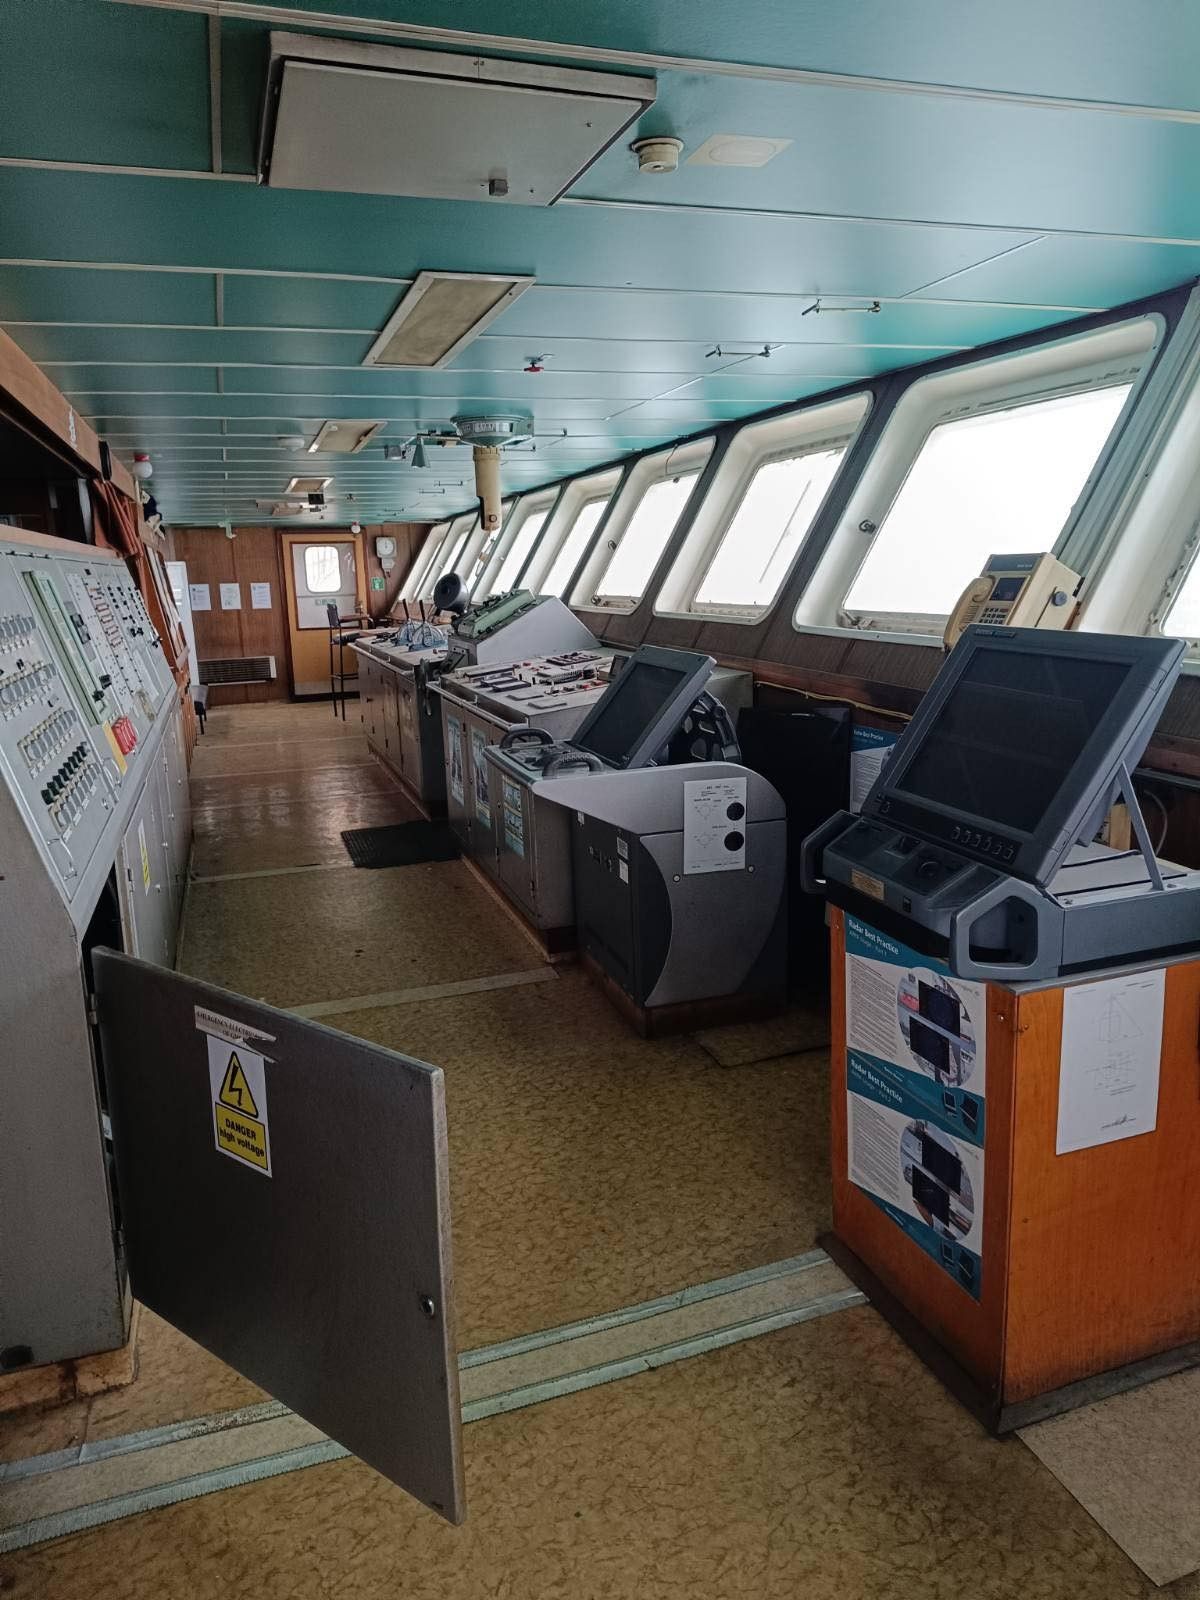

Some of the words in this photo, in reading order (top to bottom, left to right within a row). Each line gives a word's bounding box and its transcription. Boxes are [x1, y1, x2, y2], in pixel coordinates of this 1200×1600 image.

[848, 919, 864, 934] Radar
[864, 928, 876, 942] Best
[876, 935, 899, 955] Practice
[851, 1058, 867, 1076] Radar
[867, 1071, 880, 1086] Best
[880, 1080, 903, 1103] Practice
[219, 1127, 236, 1143] high
[236, 1138, 265, 1158] voltage
[225, 1118, 257, 1141] DANGER
